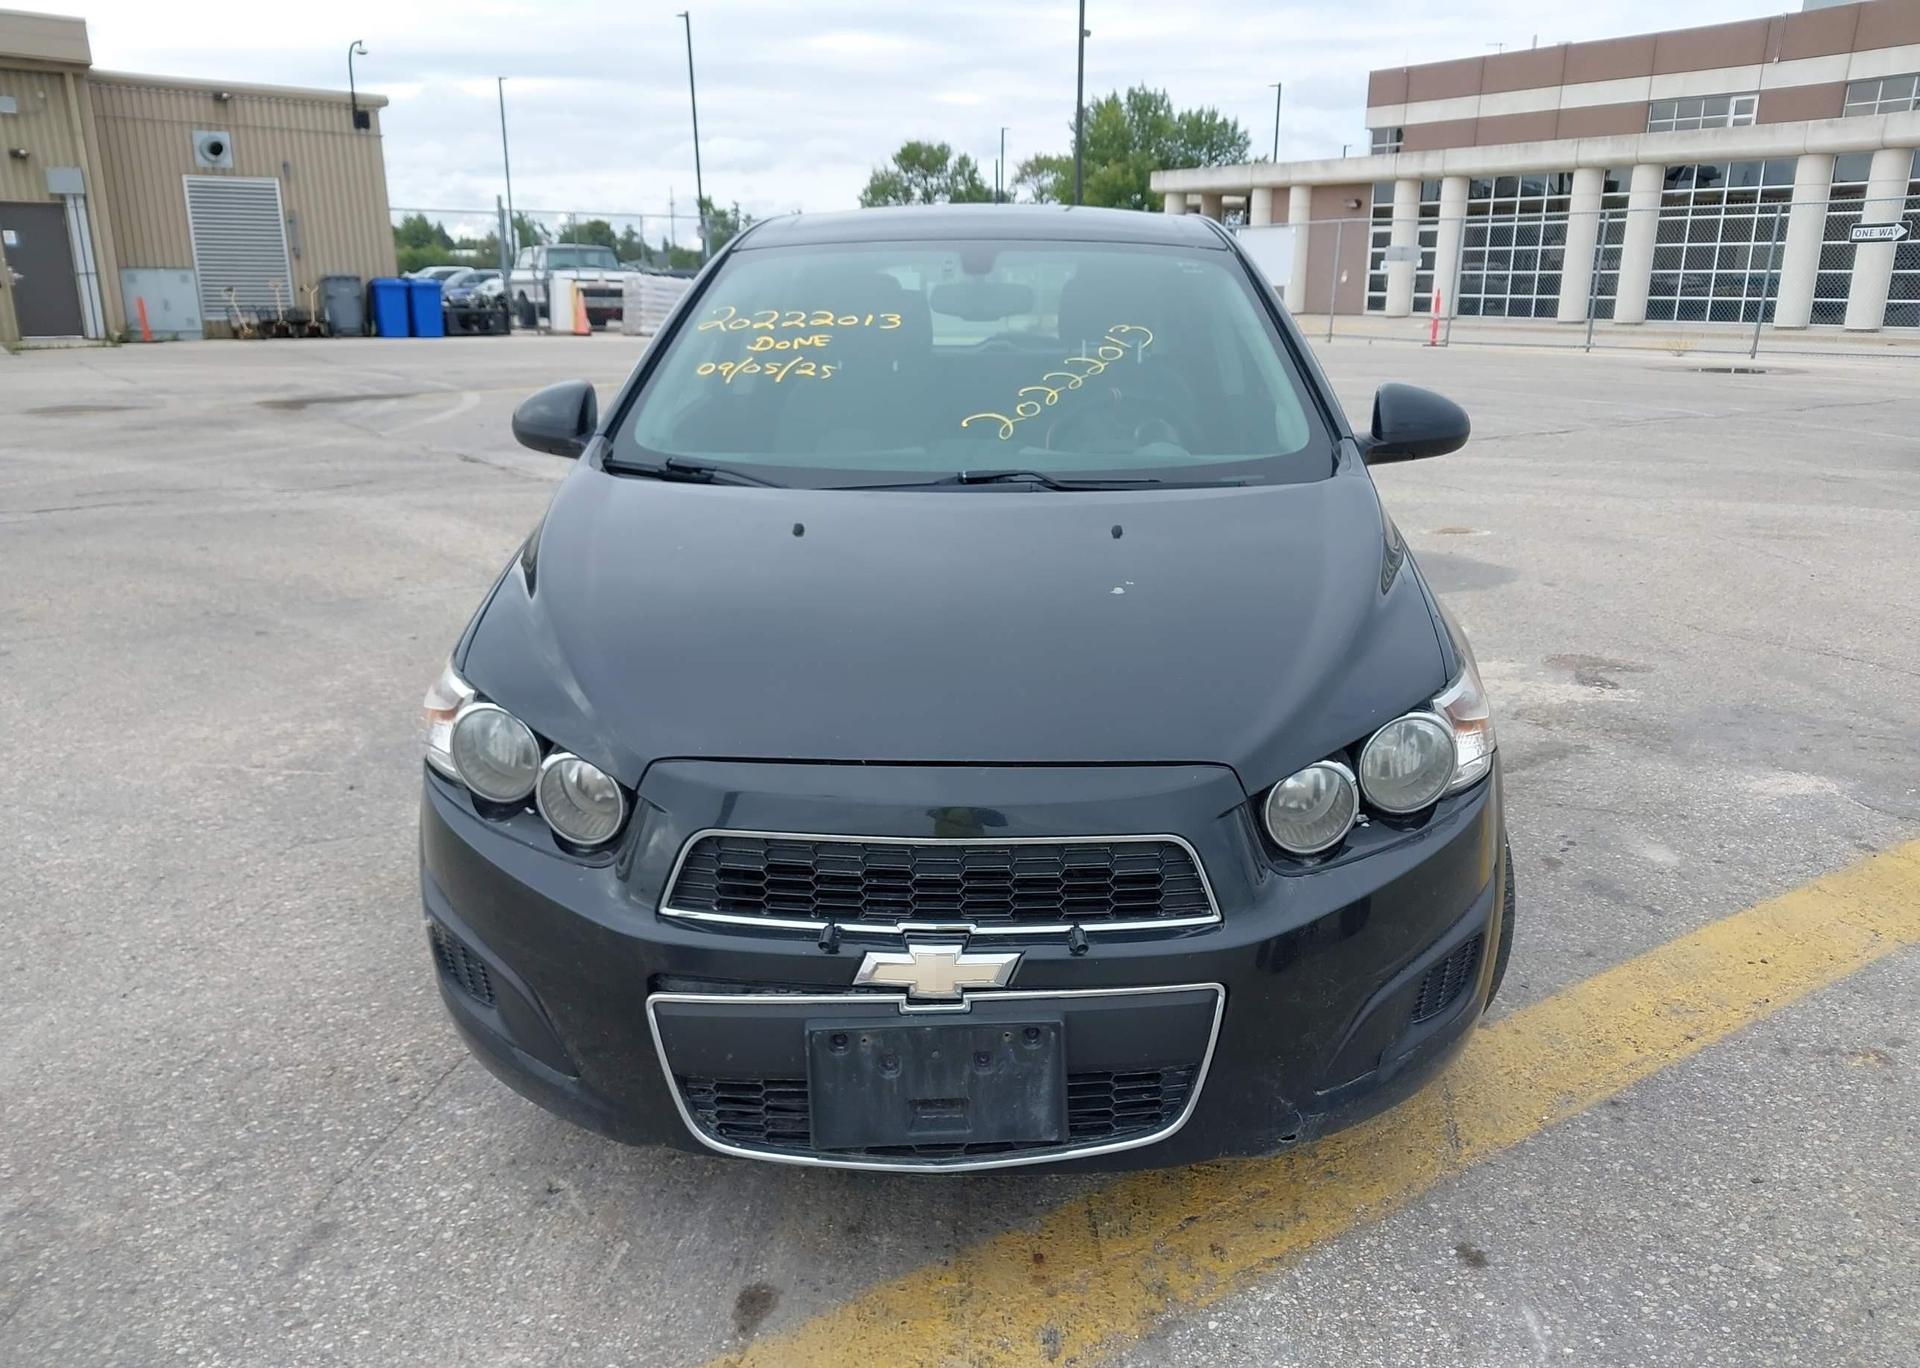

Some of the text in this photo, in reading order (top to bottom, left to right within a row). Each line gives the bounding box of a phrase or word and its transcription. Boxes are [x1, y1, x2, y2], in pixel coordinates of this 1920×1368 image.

[1855, 227, 1900, 238] ONE WAY
[697, 306, 902, 332] 20222013
[747, 334, 833, 352] DONE
[696, 356, 837, 384] 09/05/25
[961, 325, 1153, 440] 20222013
